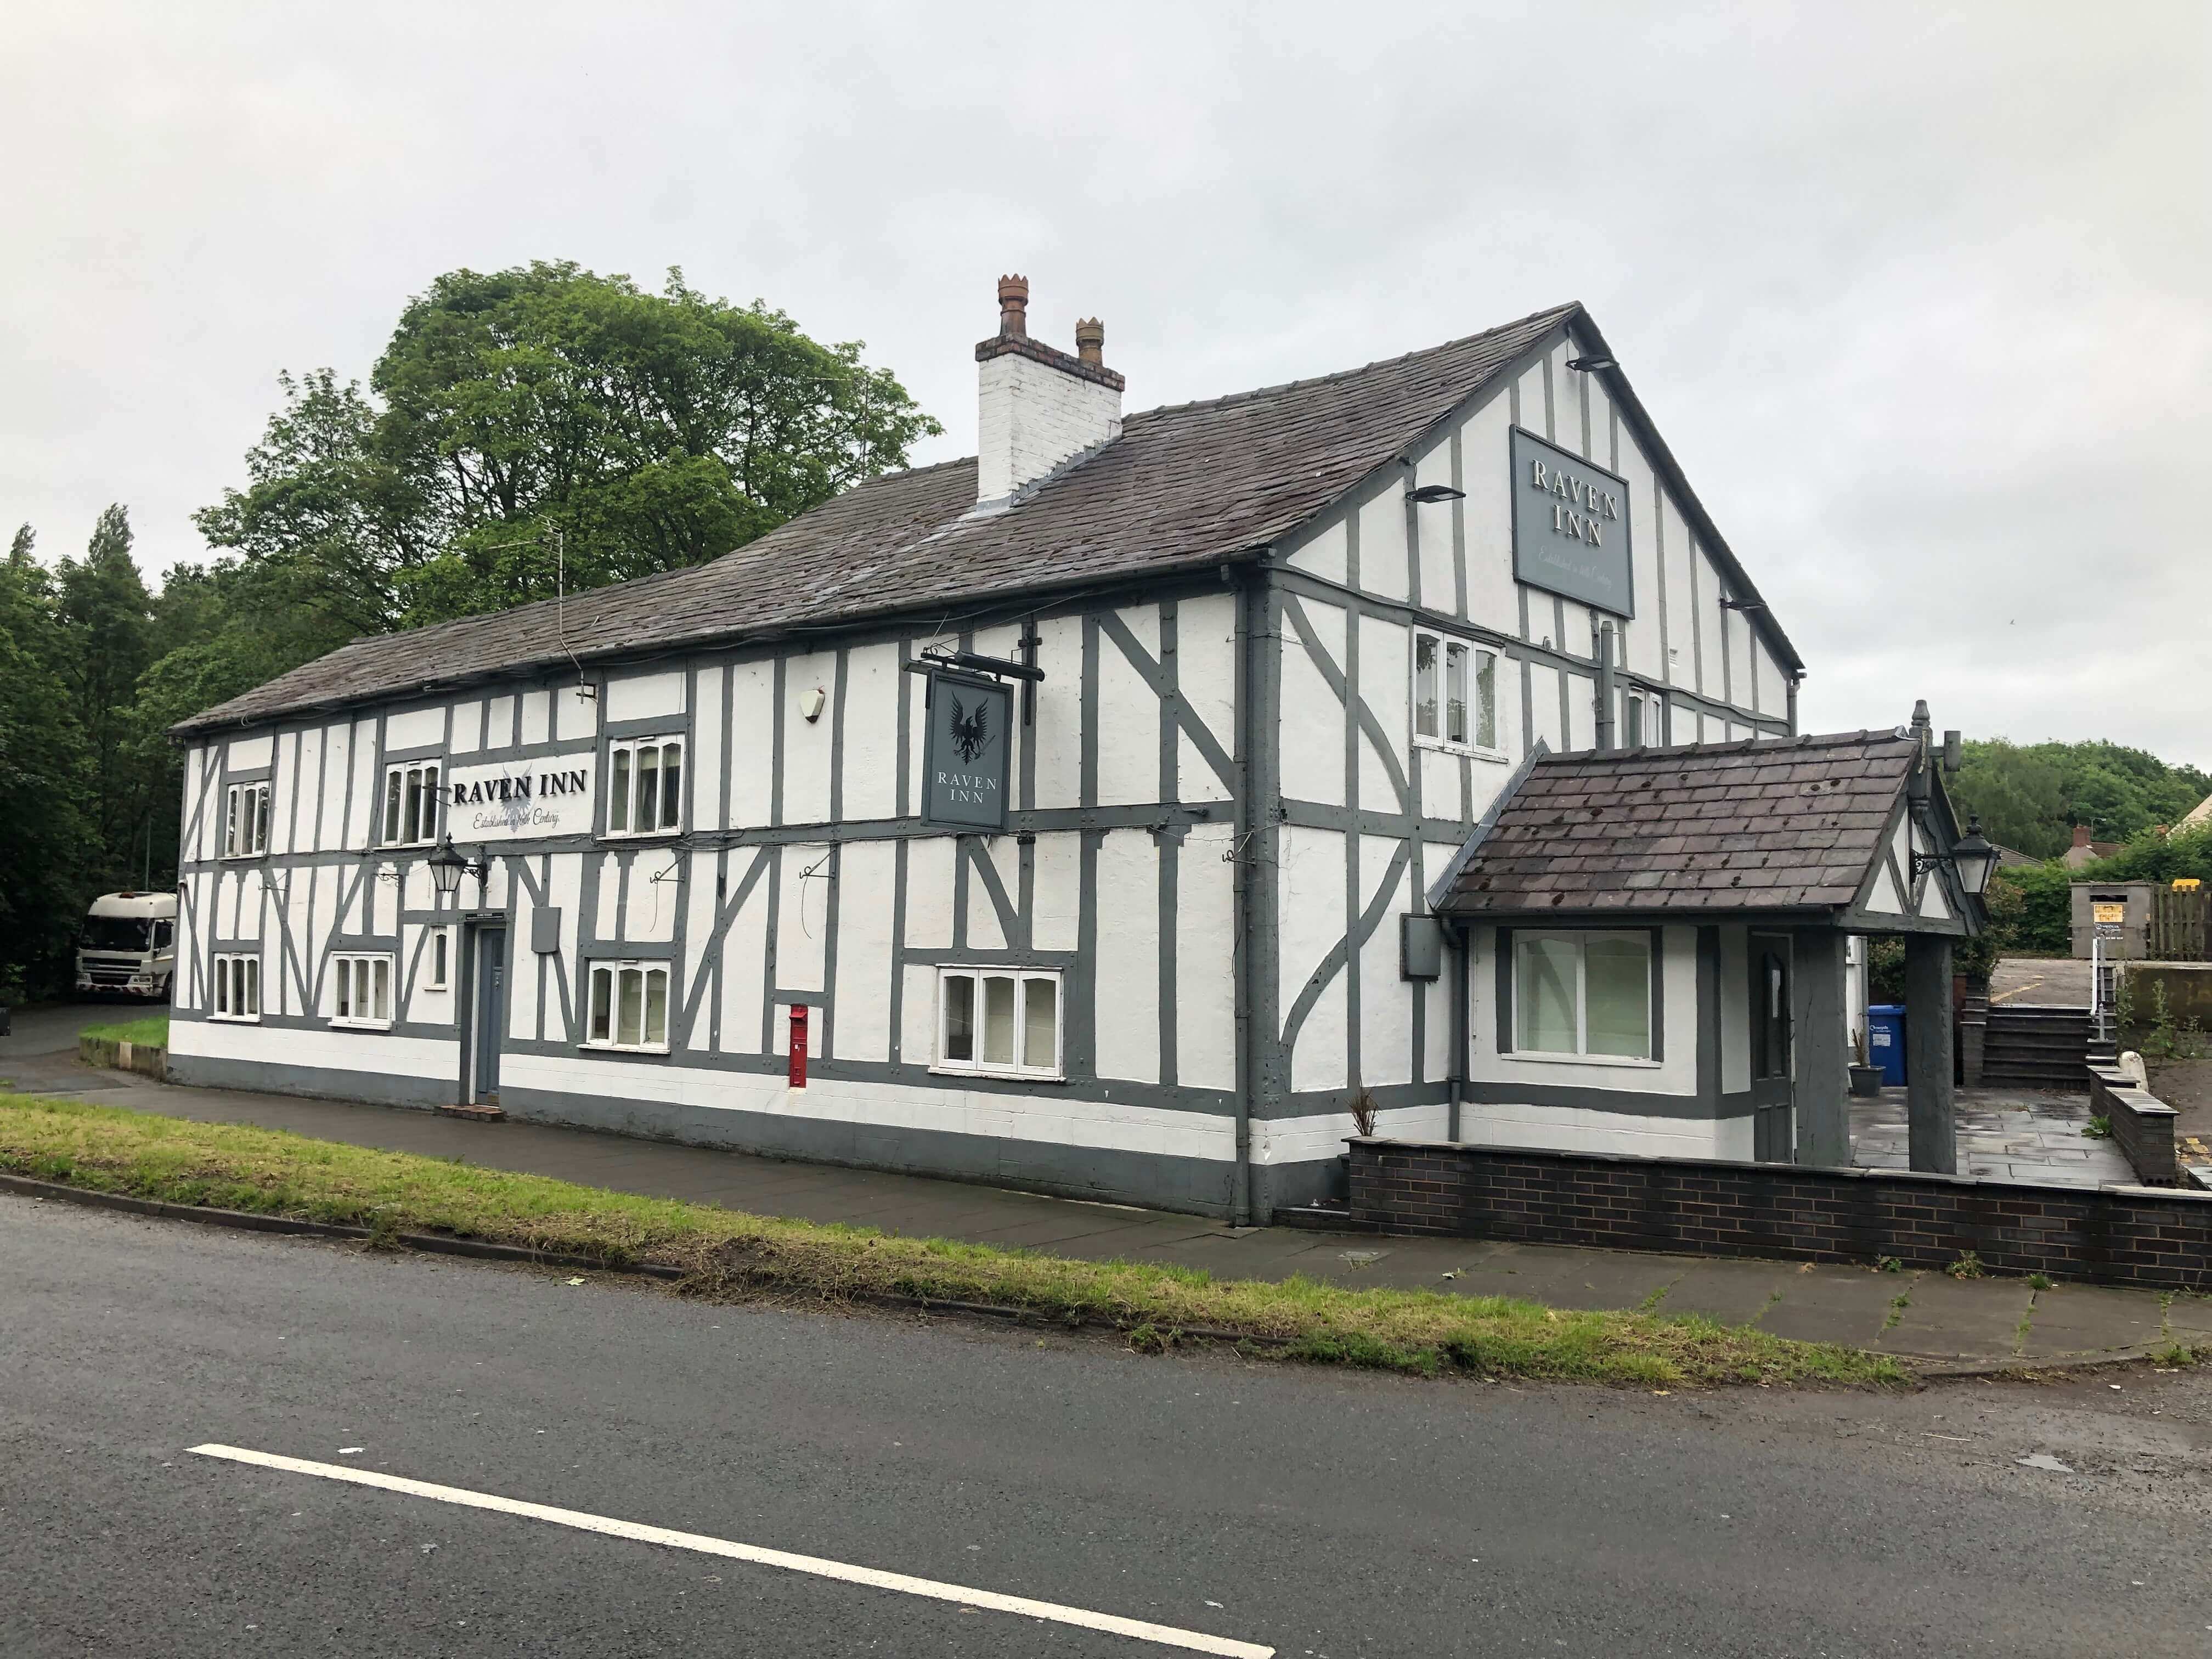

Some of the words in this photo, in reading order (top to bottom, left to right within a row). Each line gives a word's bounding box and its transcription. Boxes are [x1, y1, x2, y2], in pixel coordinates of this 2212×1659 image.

[1532, 459, 1618, 521] RAVEN
[1554, 504, 1602, 548] INN
[453, 775, 532, 804] RAVEN
[539, 769, 586, 796] INN
[938, 771, 997, 790] RAVEN
[950, 789, 984, 804] INN
[473, 812, 510, 830] Established
